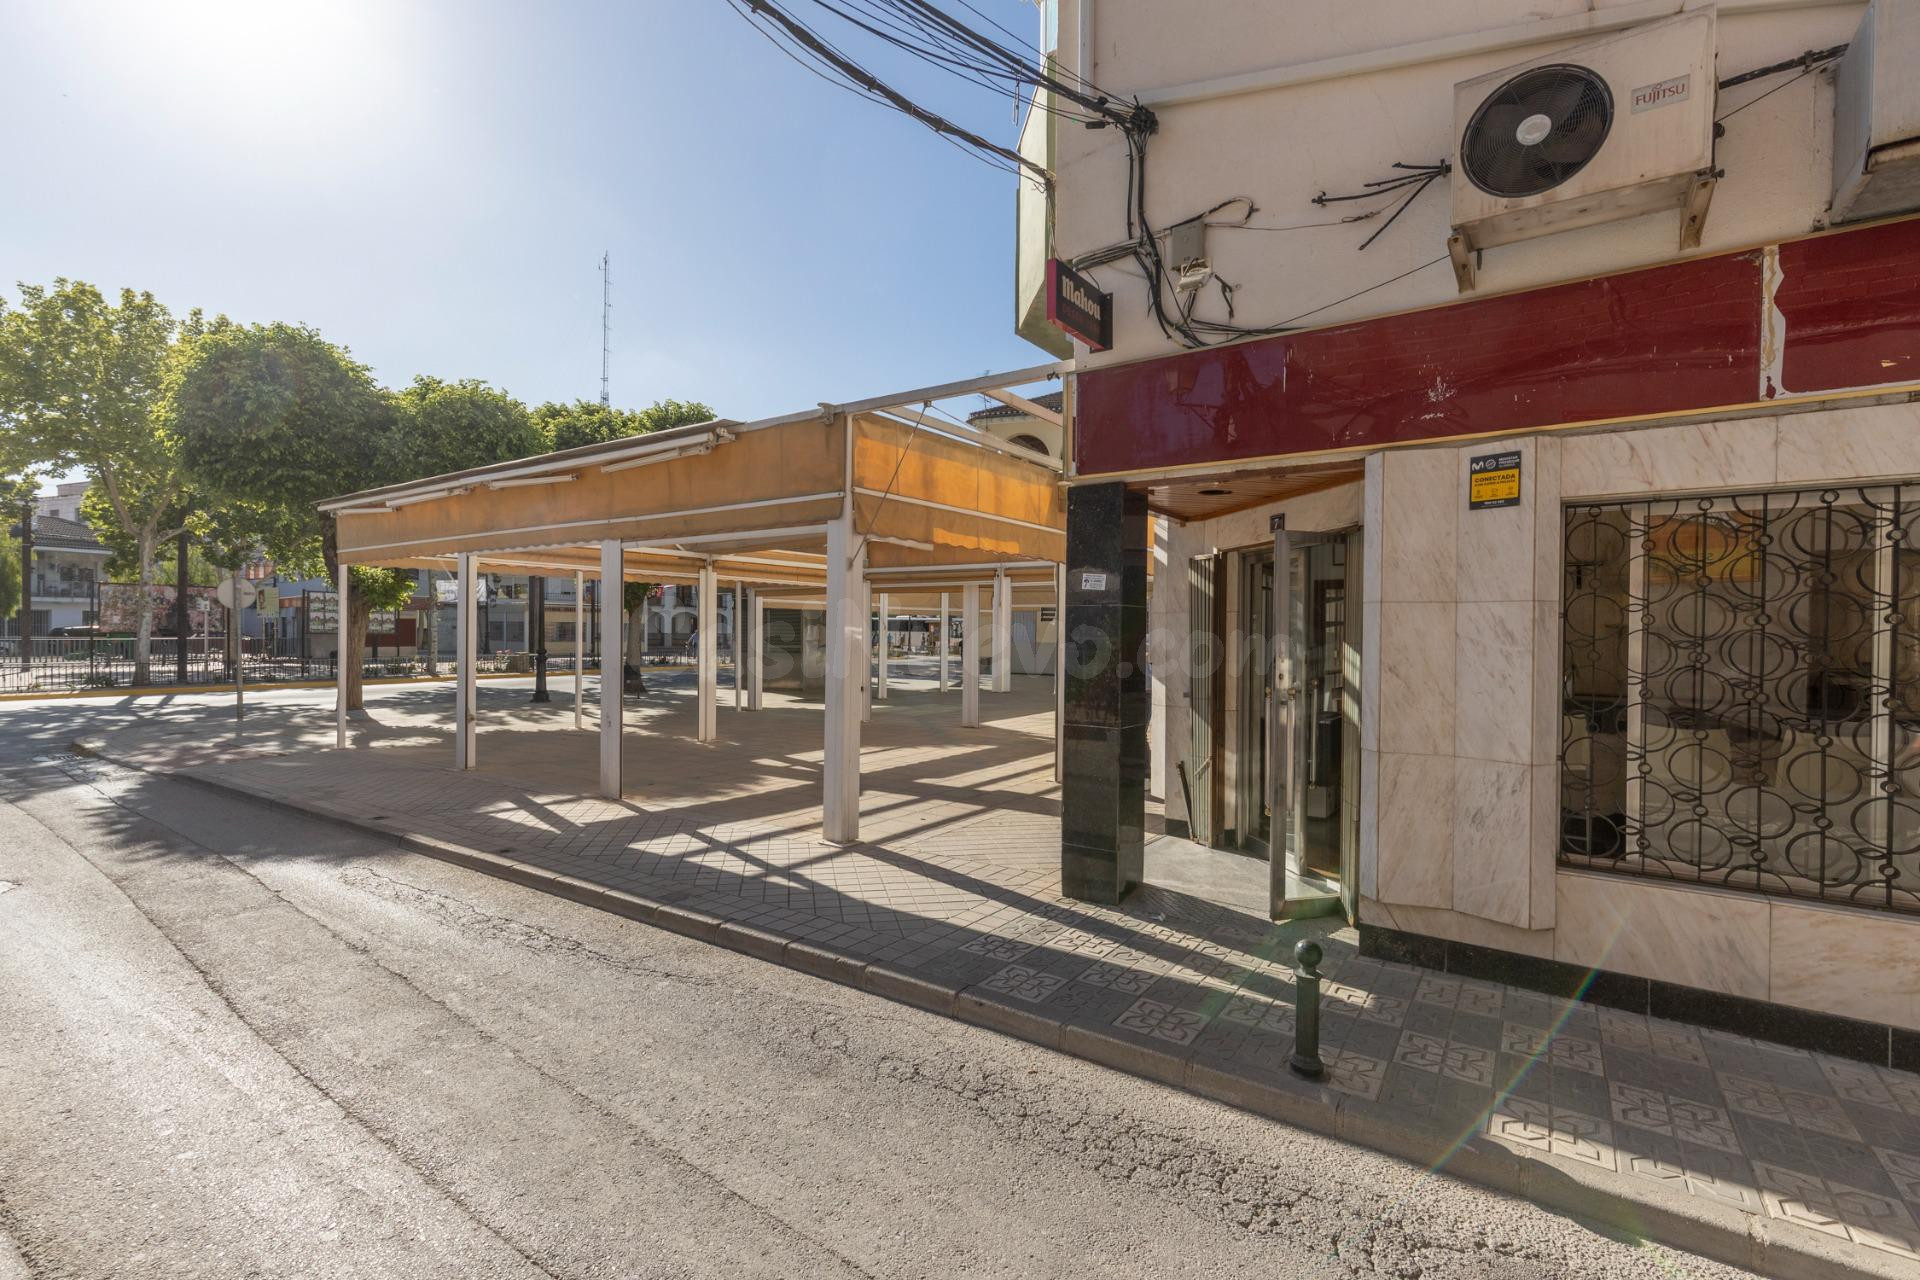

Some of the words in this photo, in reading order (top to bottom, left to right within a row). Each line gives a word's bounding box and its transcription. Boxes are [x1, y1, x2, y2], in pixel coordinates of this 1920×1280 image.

[1635, 83, 1685, 105] FUJITSU
[1061, 275, 1101, 320] Mahou
[1474, 473, 1516, 483] CONECTADA
